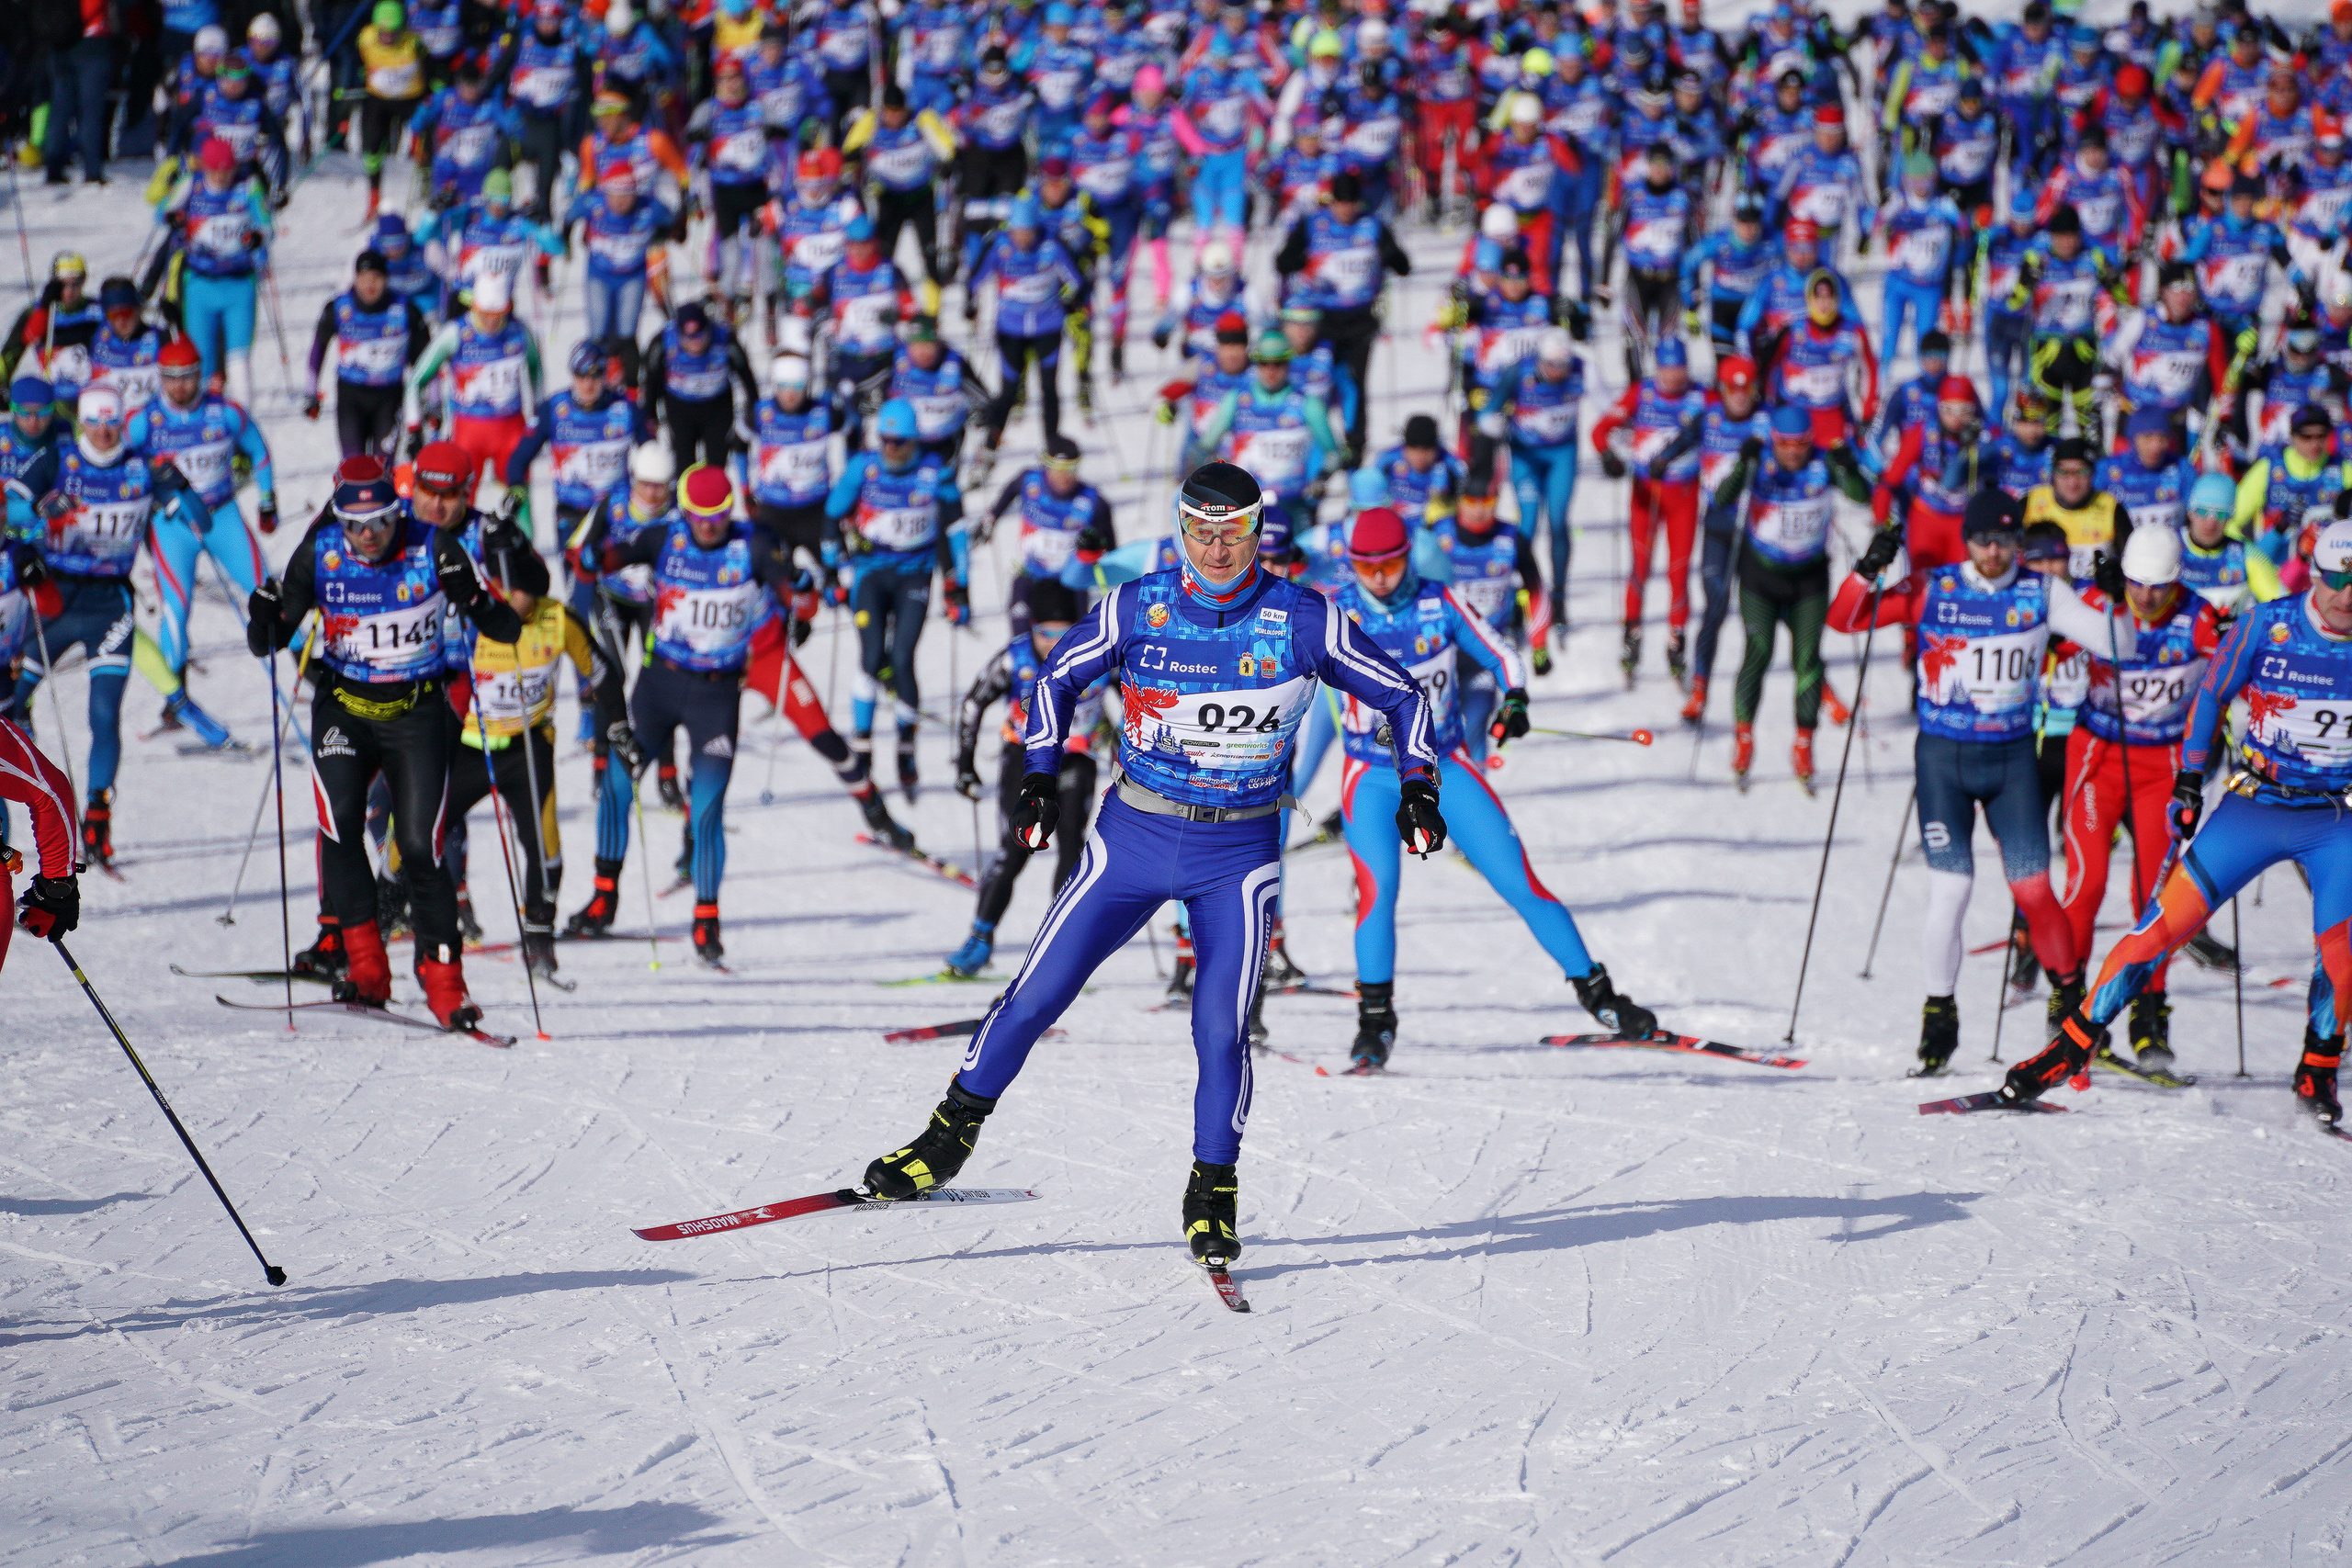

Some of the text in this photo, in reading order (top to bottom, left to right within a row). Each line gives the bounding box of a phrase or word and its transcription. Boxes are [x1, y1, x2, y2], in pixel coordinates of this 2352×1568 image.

[347, 592, 383, 604] Rostec
[1262, 610, 1285, 620] 50 km
[367, 607, 437, 649] 1145
[1169, 660, 1218, 674] Rostec
[1972, 645, 2037, 681] 1106
[2288, 670, 2335, 687] Rostec
[1198, 703, 1281, 734] 926
[852, 1201, 891, 1213] MADSHUS
[676, 1214, 740, 1235] MADSHUS
